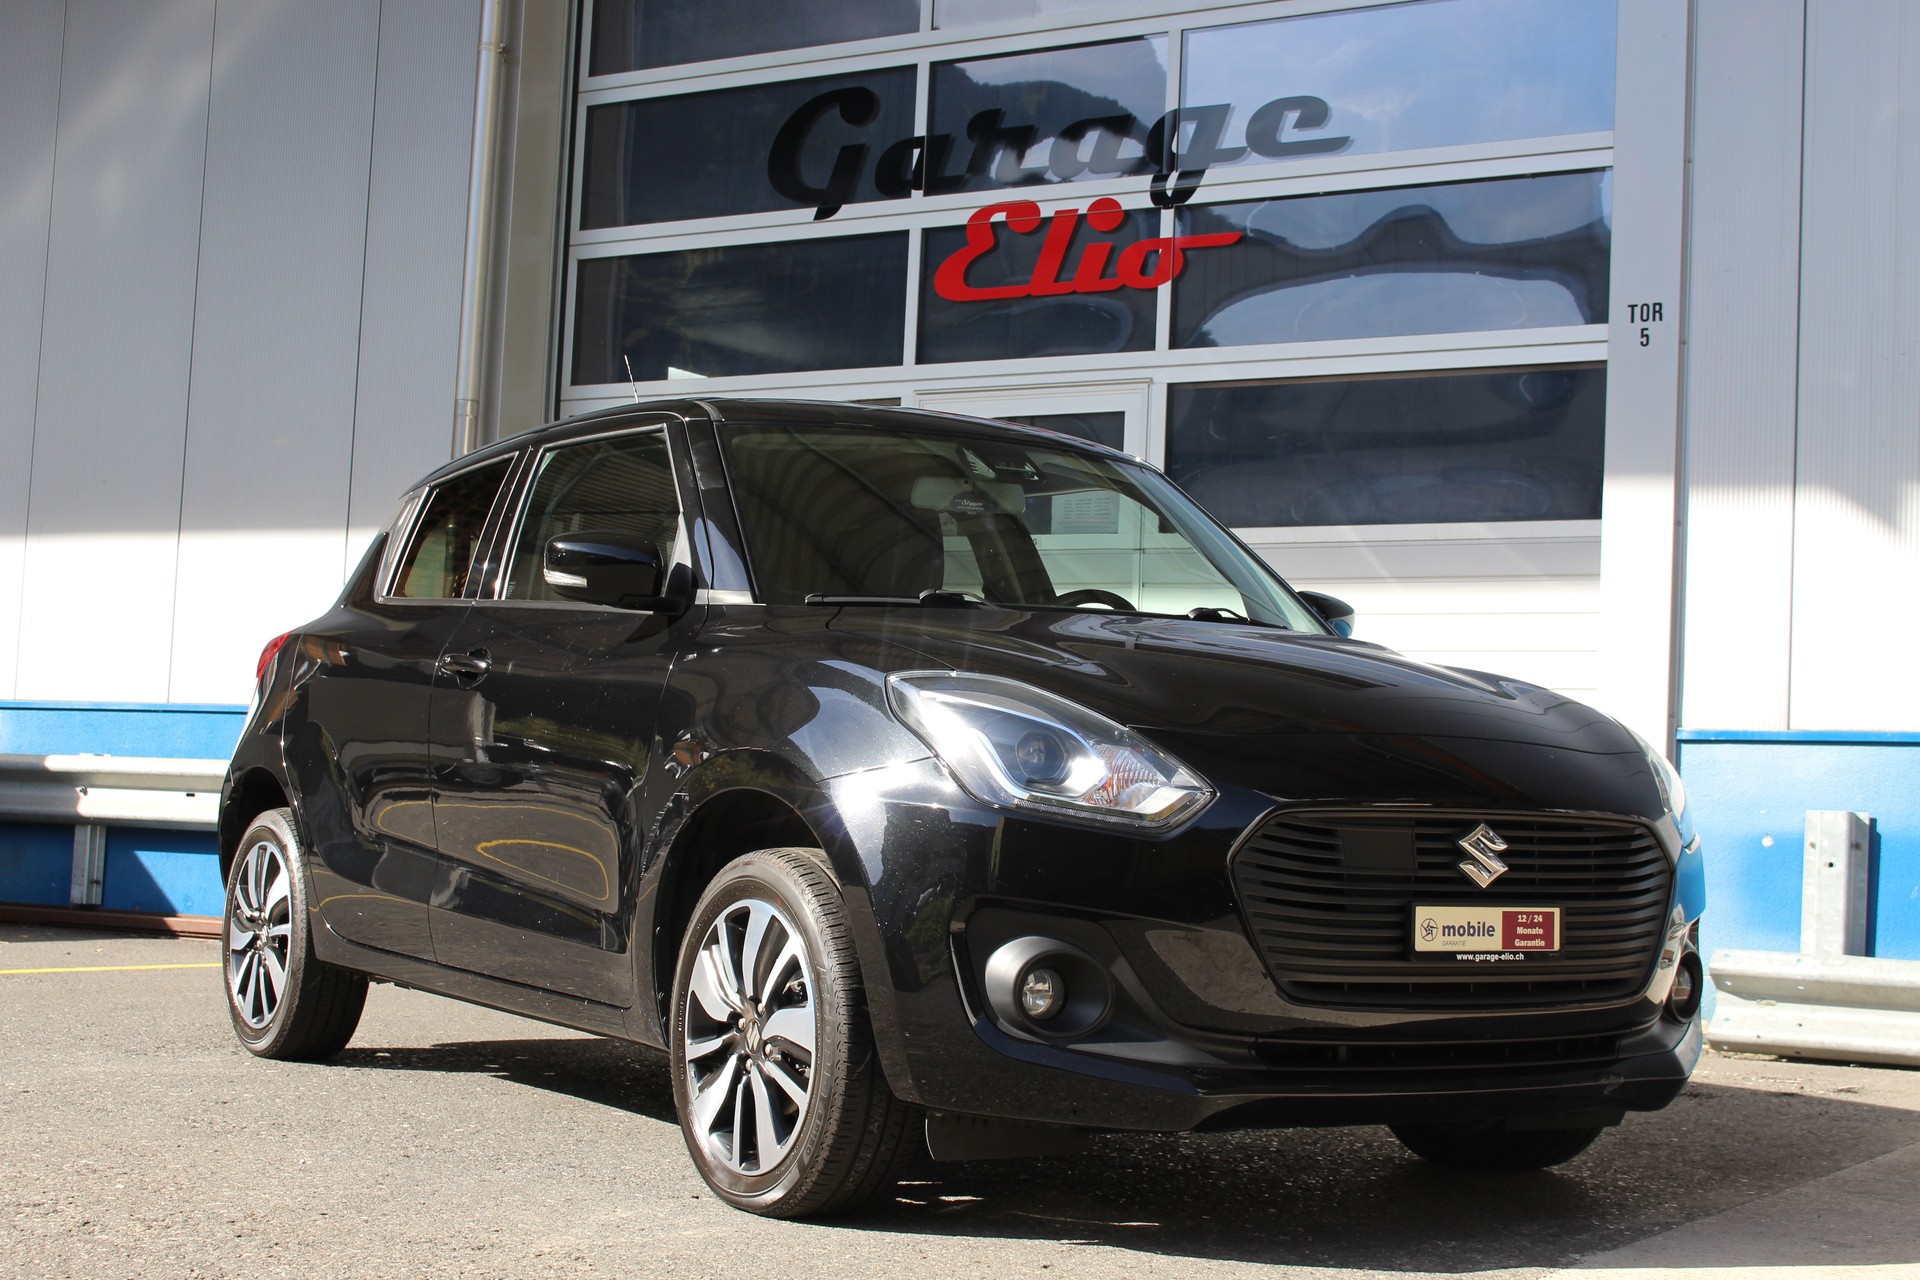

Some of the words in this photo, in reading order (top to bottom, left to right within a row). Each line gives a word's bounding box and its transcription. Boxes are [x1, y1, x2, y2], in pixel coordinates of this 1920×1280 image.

[766, 86, 1352, 220] Garage
[933, 197, 1242, 301] Elio
[1627, 302, 1663, 323] TOR
[1640, 327, 1650, 347] 5
[1517, 914, 1527, 923] 12
[1533, 914, 1543, 923] 24
[1441, 921, 1496, 937] mobile
[1516, 926, 1544, 935] Monate
[1441, 939, 1467, 947] GARANTIE
[1514, 938, 1545, 947] Garantie
[1456, 952, 1524, 962] www.garage-elio.ch
